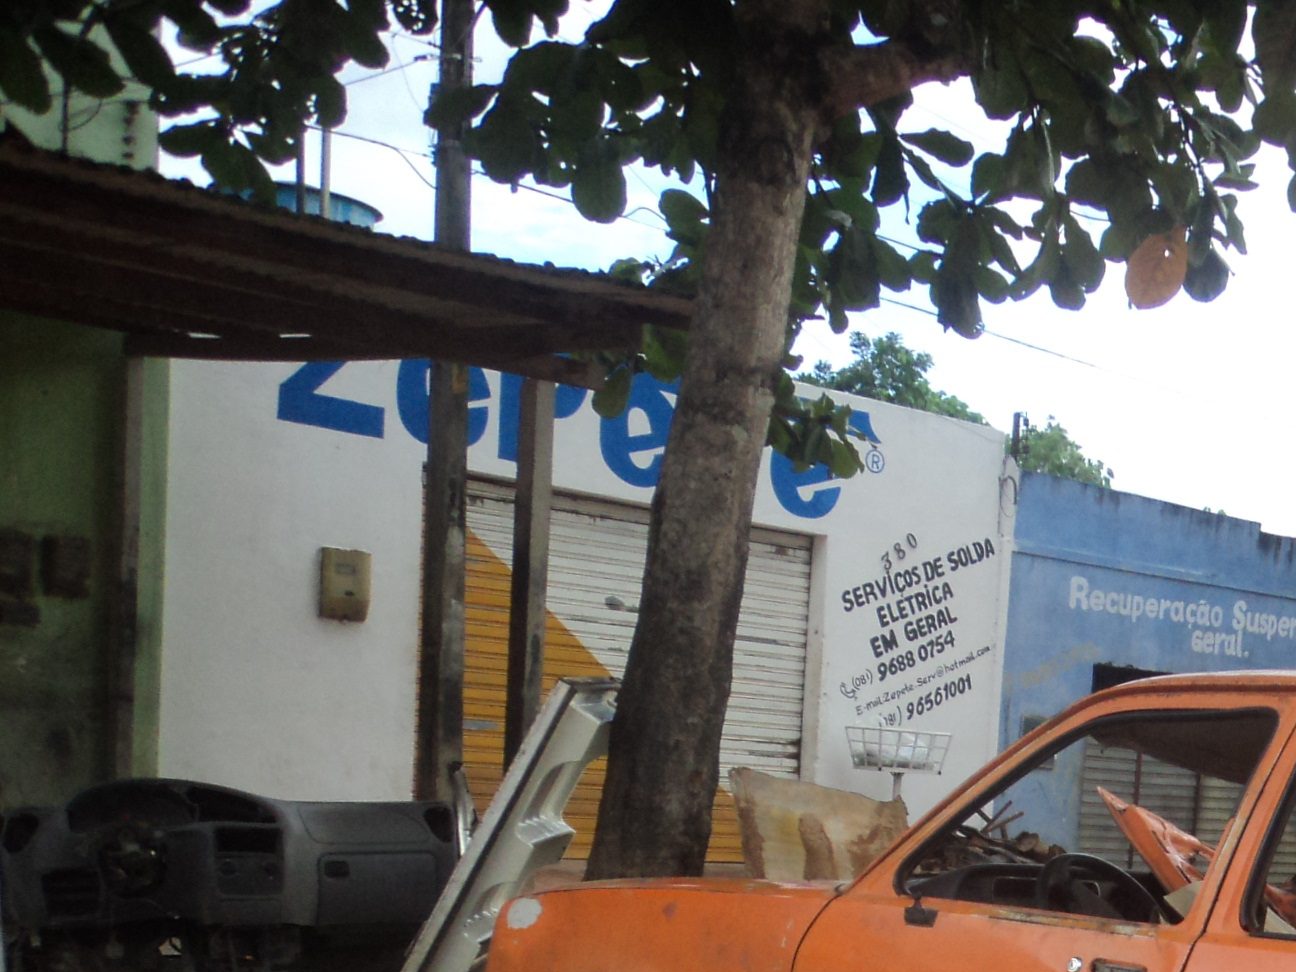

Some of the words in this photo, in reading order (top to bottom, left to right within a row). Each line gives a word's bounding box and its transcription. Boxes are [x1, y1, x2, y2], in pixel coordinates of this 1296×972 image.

[921, 556, 945, 583] DE
[946, 537, 996, 572] SOLDA
[1068, 575, 1224, 630] Recuperação
[869, 634, 899, 659] EM
[903, 605, 958, 642] GERAL
[877, 649, 916, 682] 9688
[917, 629, 956, 661] 0754
[906, 672, 973, 721] 96561001
